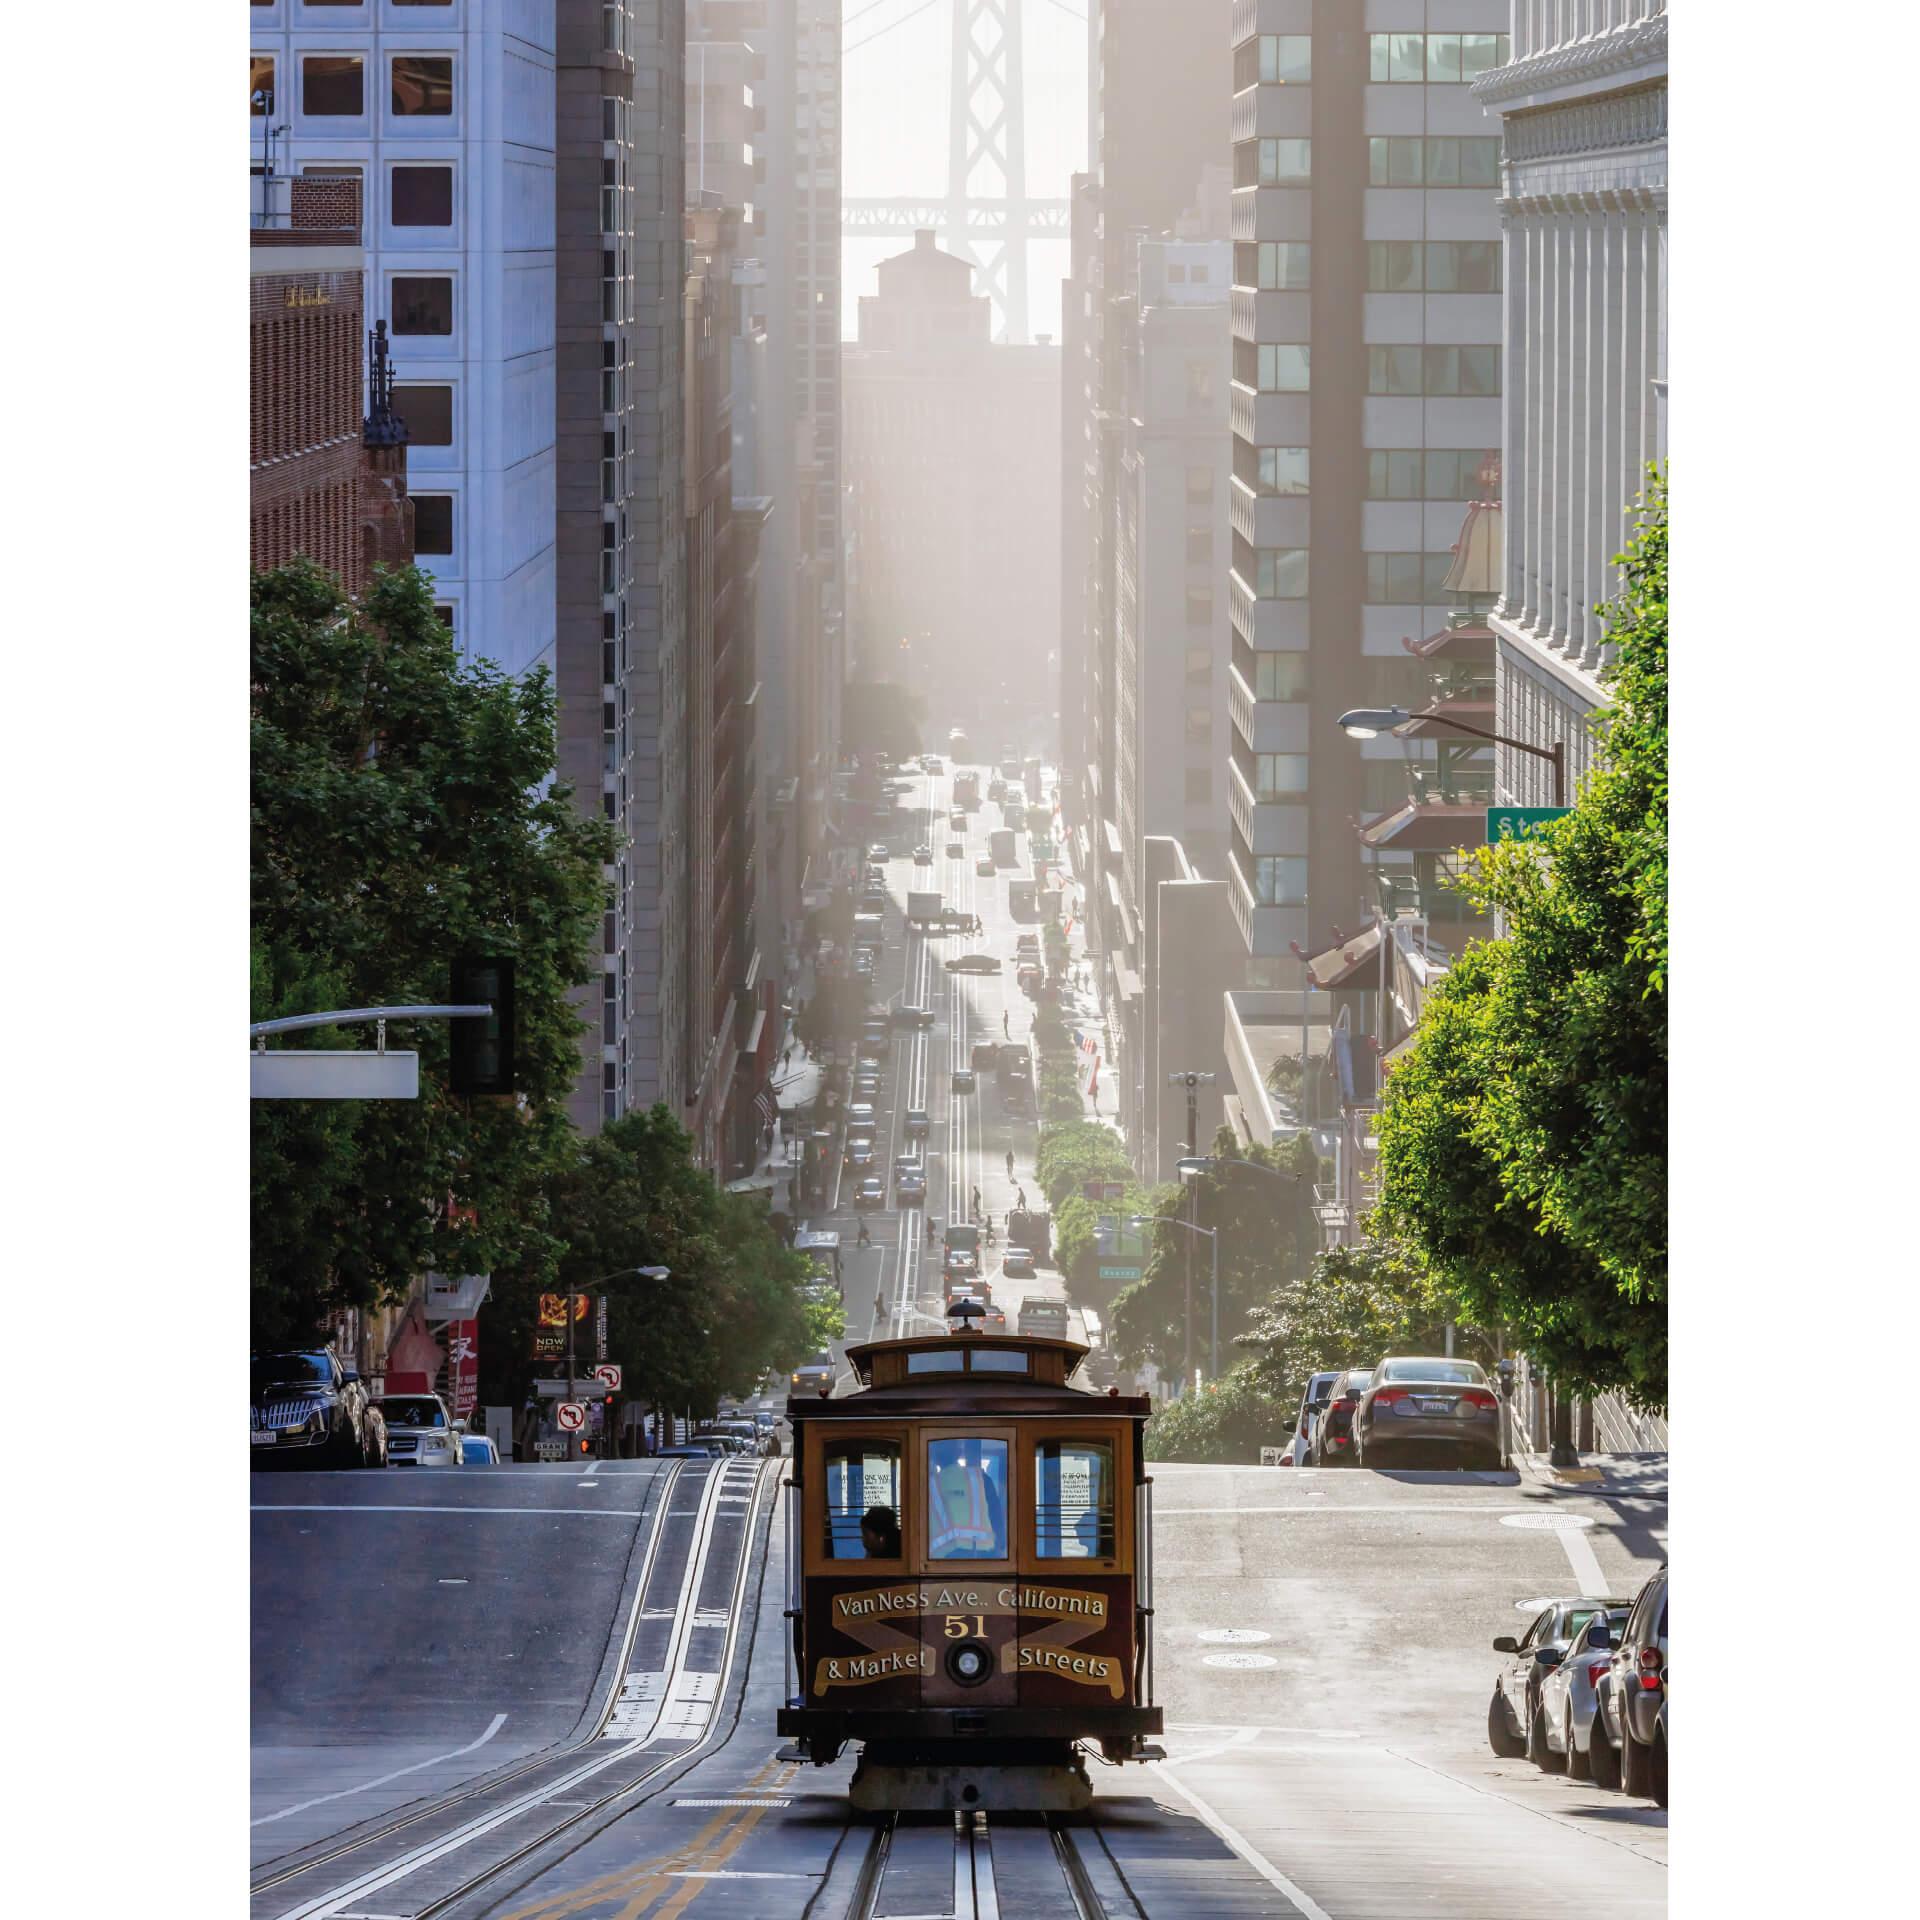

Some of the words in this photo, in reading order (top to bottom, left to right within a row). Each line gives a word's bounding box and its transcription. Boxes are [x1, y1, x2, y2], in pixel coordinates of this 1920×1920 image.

[838, 1597, 875, 1616] Van
[878, 1592, 929, 1611] Ness
[998, 1588, 1103, 1616] California
[944, 1615, 989, 1638] 51
[828, 1660, 844, 1679] &
[849, 1650, 926, 1678] Market
[1019, 1648, 1109, 1677] Streets
